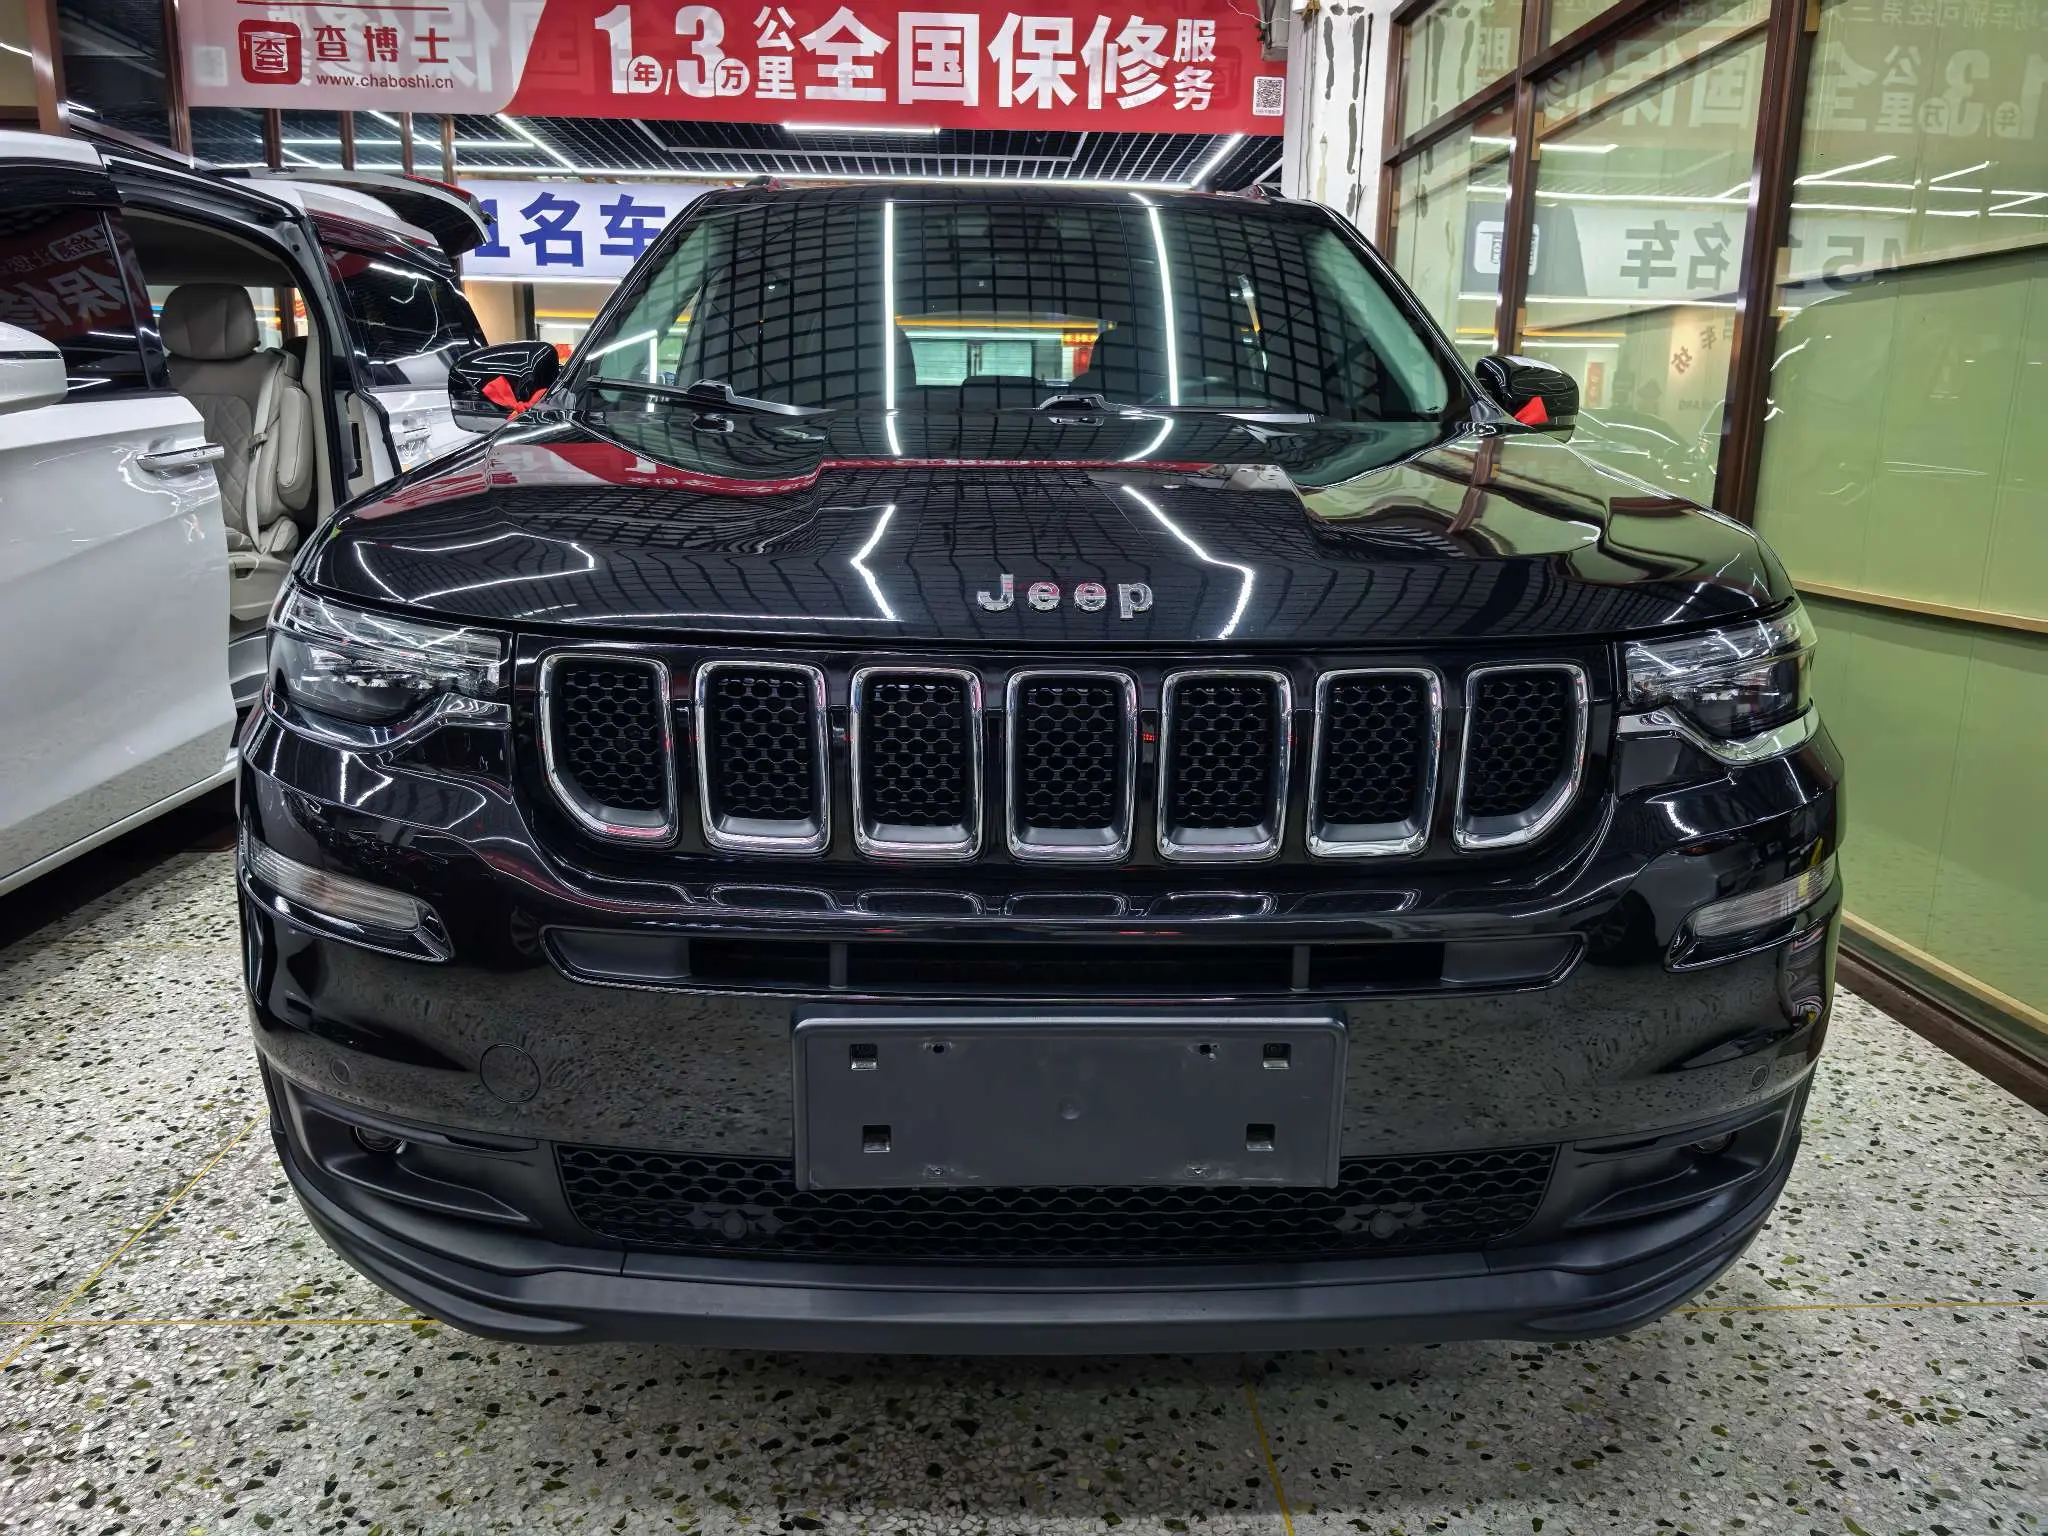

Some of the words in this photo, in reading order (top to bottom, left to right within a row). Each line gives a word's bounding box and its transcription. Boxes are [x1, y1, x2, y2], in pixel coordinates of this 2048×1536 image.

[313, 25, 450, 63] 查博士
[316, 73, 454, 89] www.chaboshi.cn
[976, 572, 1154, 620] Jeep
